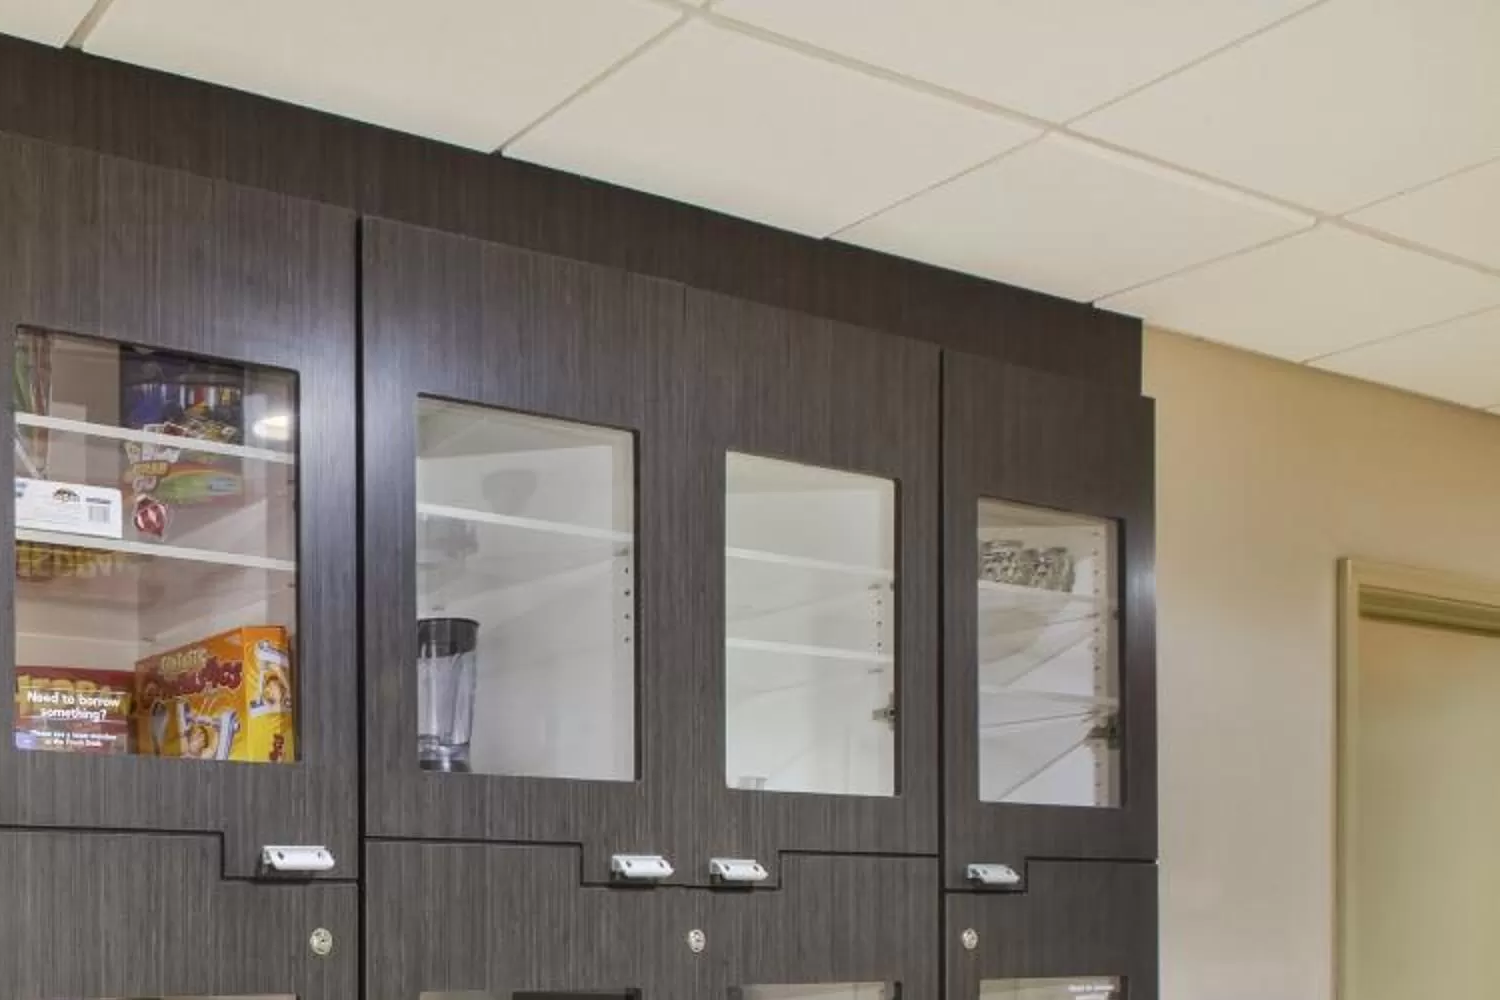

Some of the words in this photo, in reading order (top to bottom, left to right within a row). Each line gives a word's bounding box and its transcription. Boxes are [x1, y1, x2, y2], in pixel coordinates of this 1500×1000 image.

[27, 690, 58, 704] Need
[62, 691, 75, 704] to
[79, 693, 120, 708] borrow
[40, 707, 107, 722] something?
